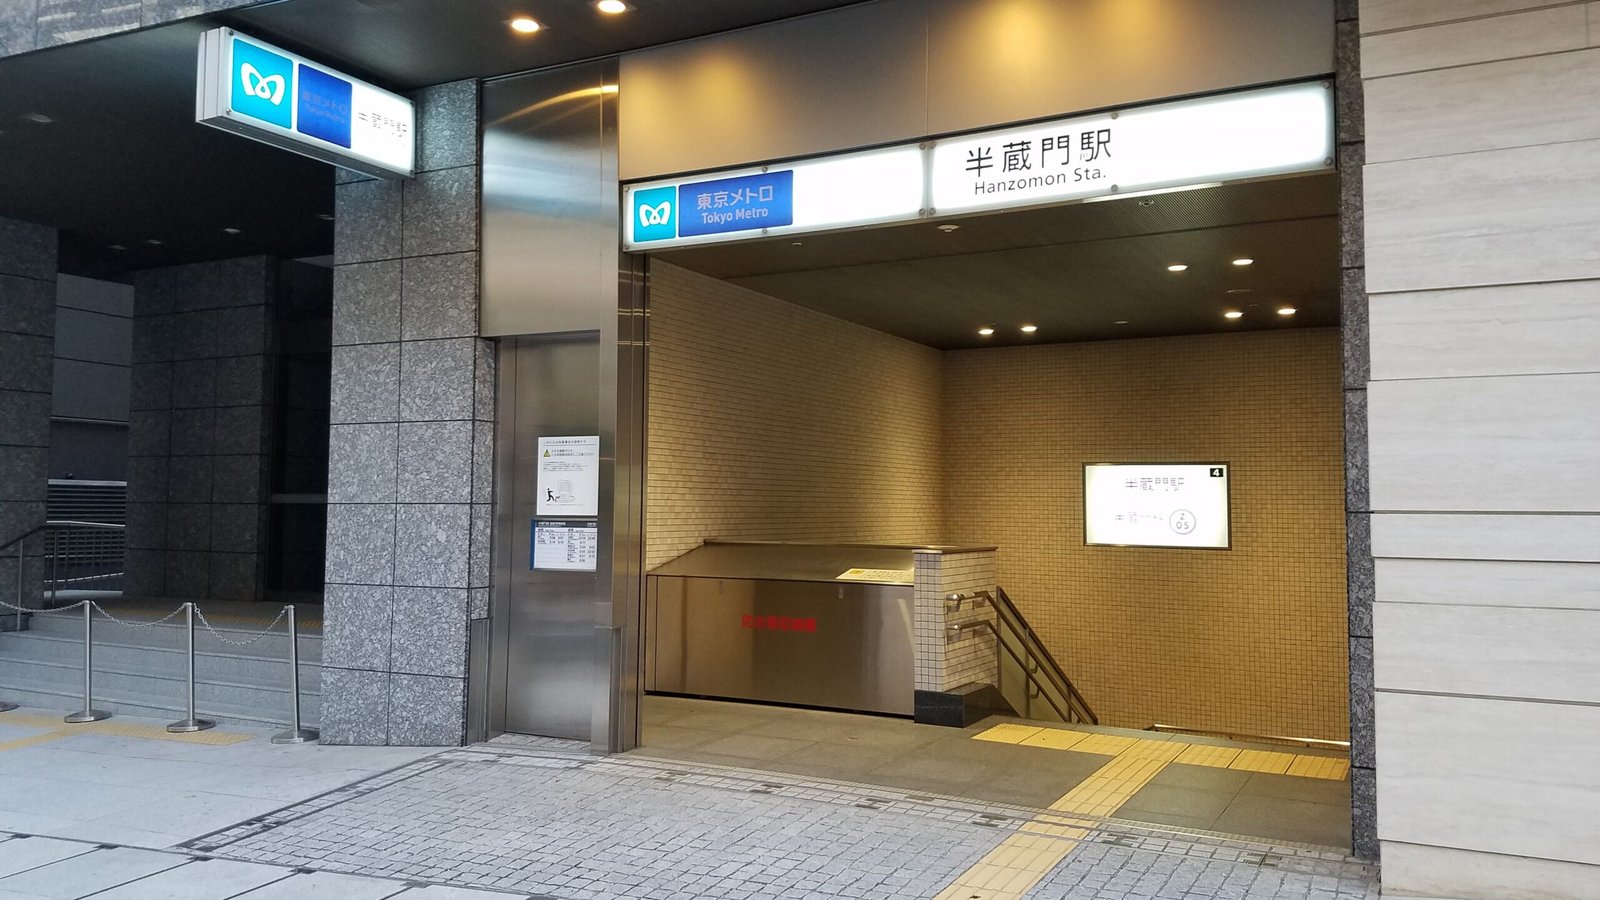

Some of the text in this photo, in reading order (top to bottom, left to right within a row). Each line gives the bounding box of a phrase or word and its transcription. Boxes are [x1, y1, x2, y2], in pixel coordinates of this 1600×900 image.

[965, 128, 1112, 178] 半蔵門駅
[974, 166, 1107, 195] Hanzomon Sta.
[696, 185, 774, 210] 東京メトロ
[701, 207, 769, 225] Tokyo Metro
[1212, 468, 1220, 477] 4
